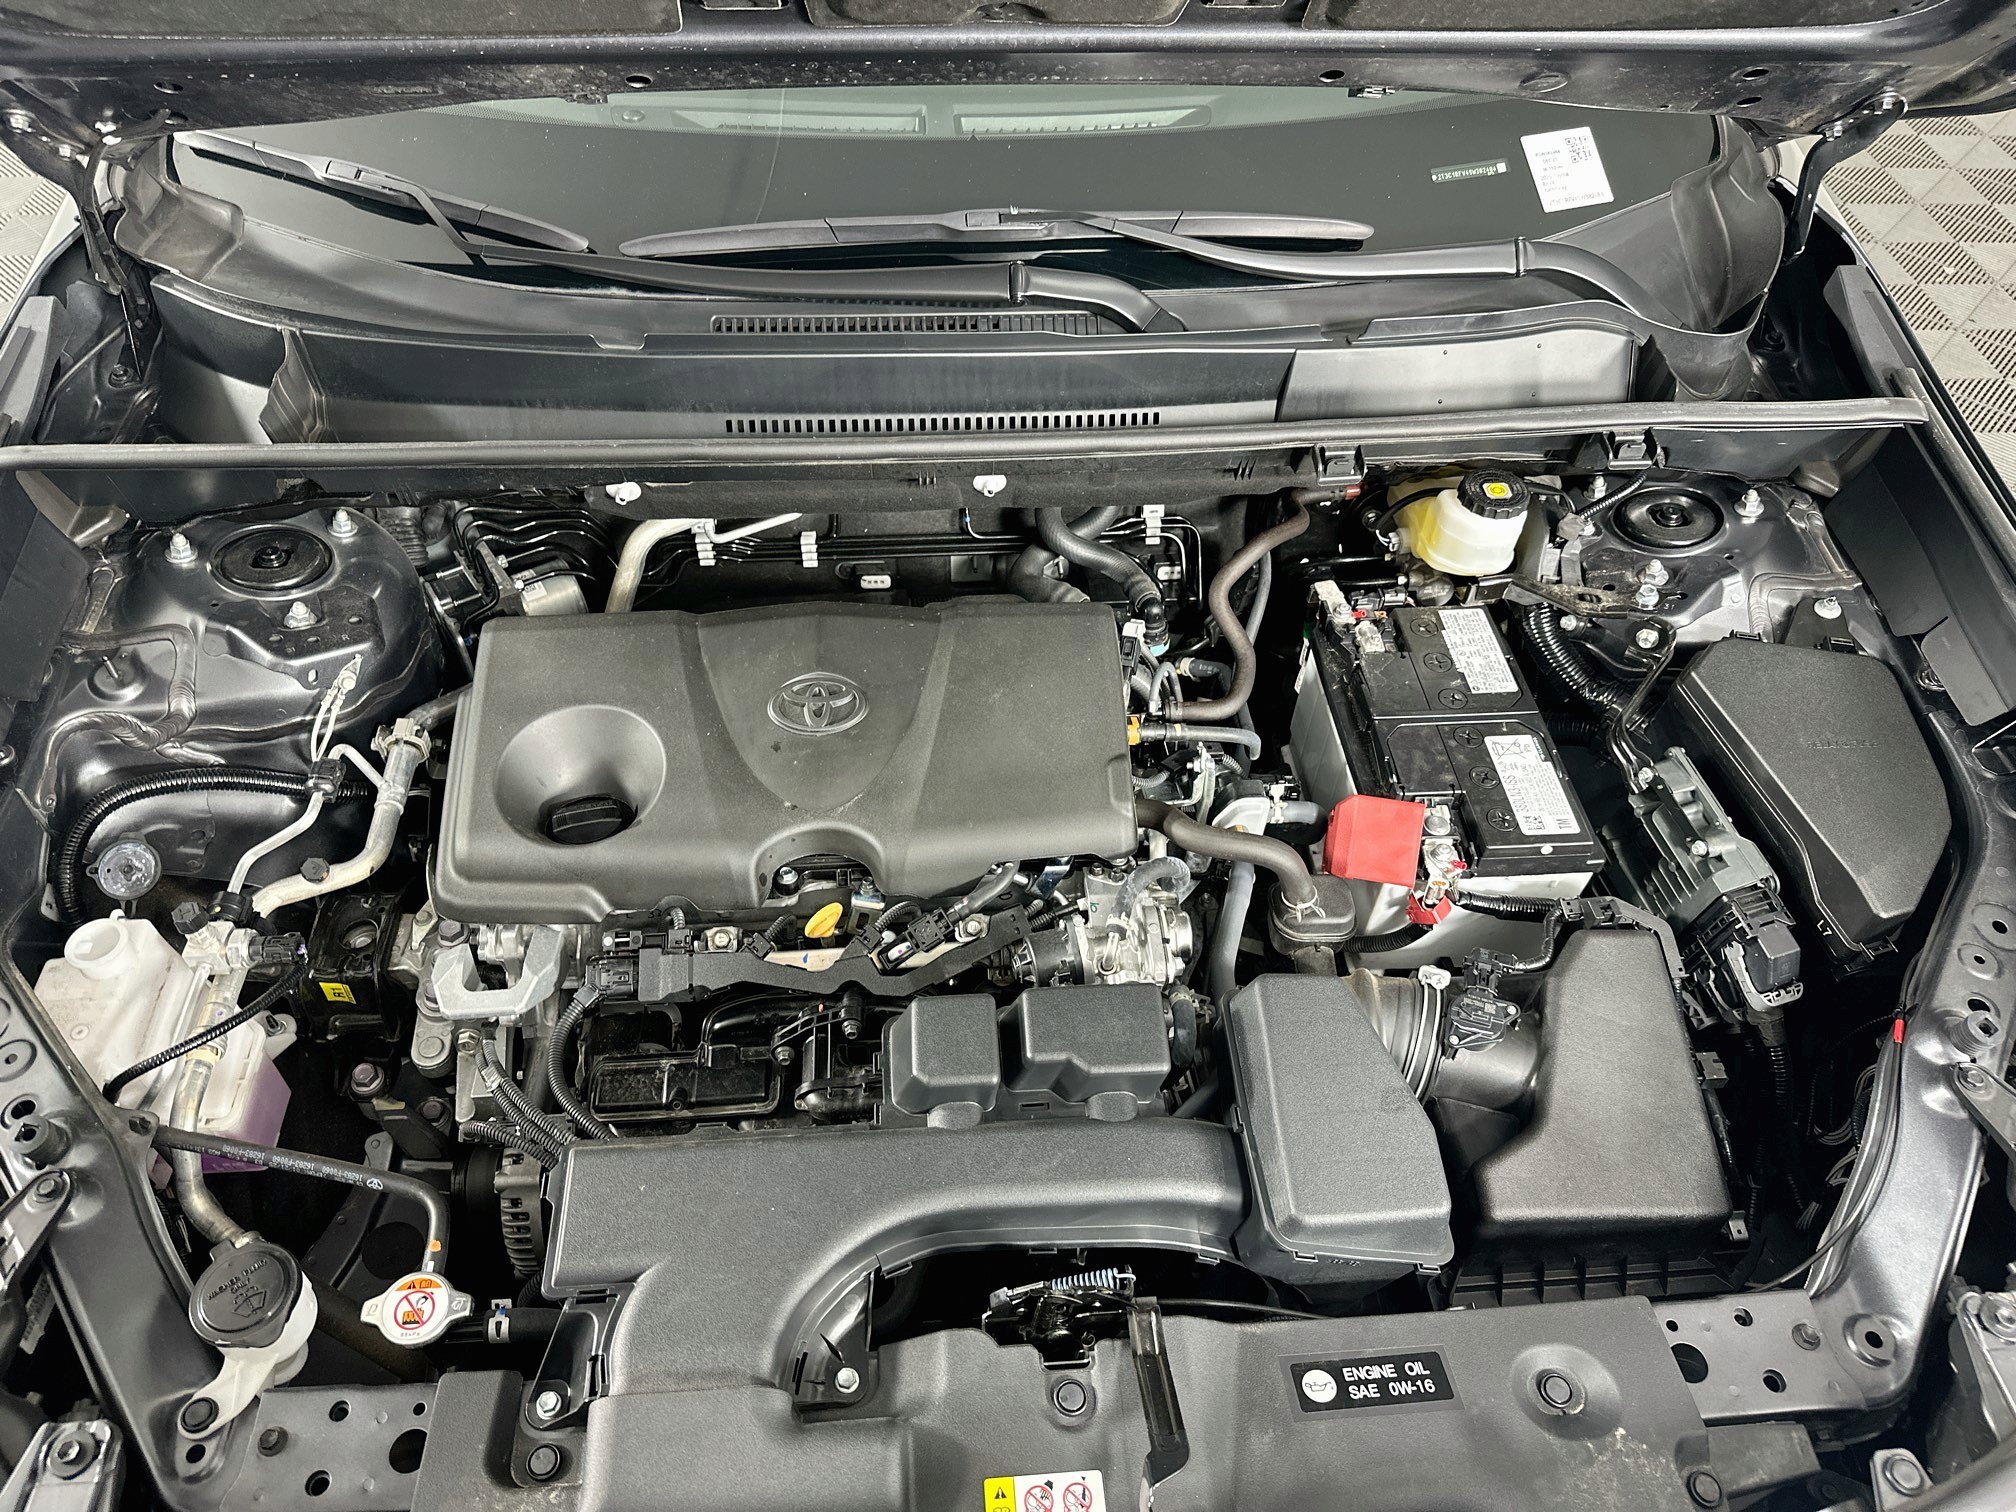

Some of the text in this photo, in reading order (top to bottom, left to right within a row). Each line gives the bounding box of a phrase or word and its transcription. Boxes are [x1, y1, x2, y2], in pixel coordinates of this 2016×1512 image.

[1556, 818, 1572, 830] TM
[207, 1259, 268, 1301] WASHER FLUID
[1342, 1361, 1431, 1382] ENGINE OIL
[1348, 1379, 1436, 1400] SAE 0W-16
